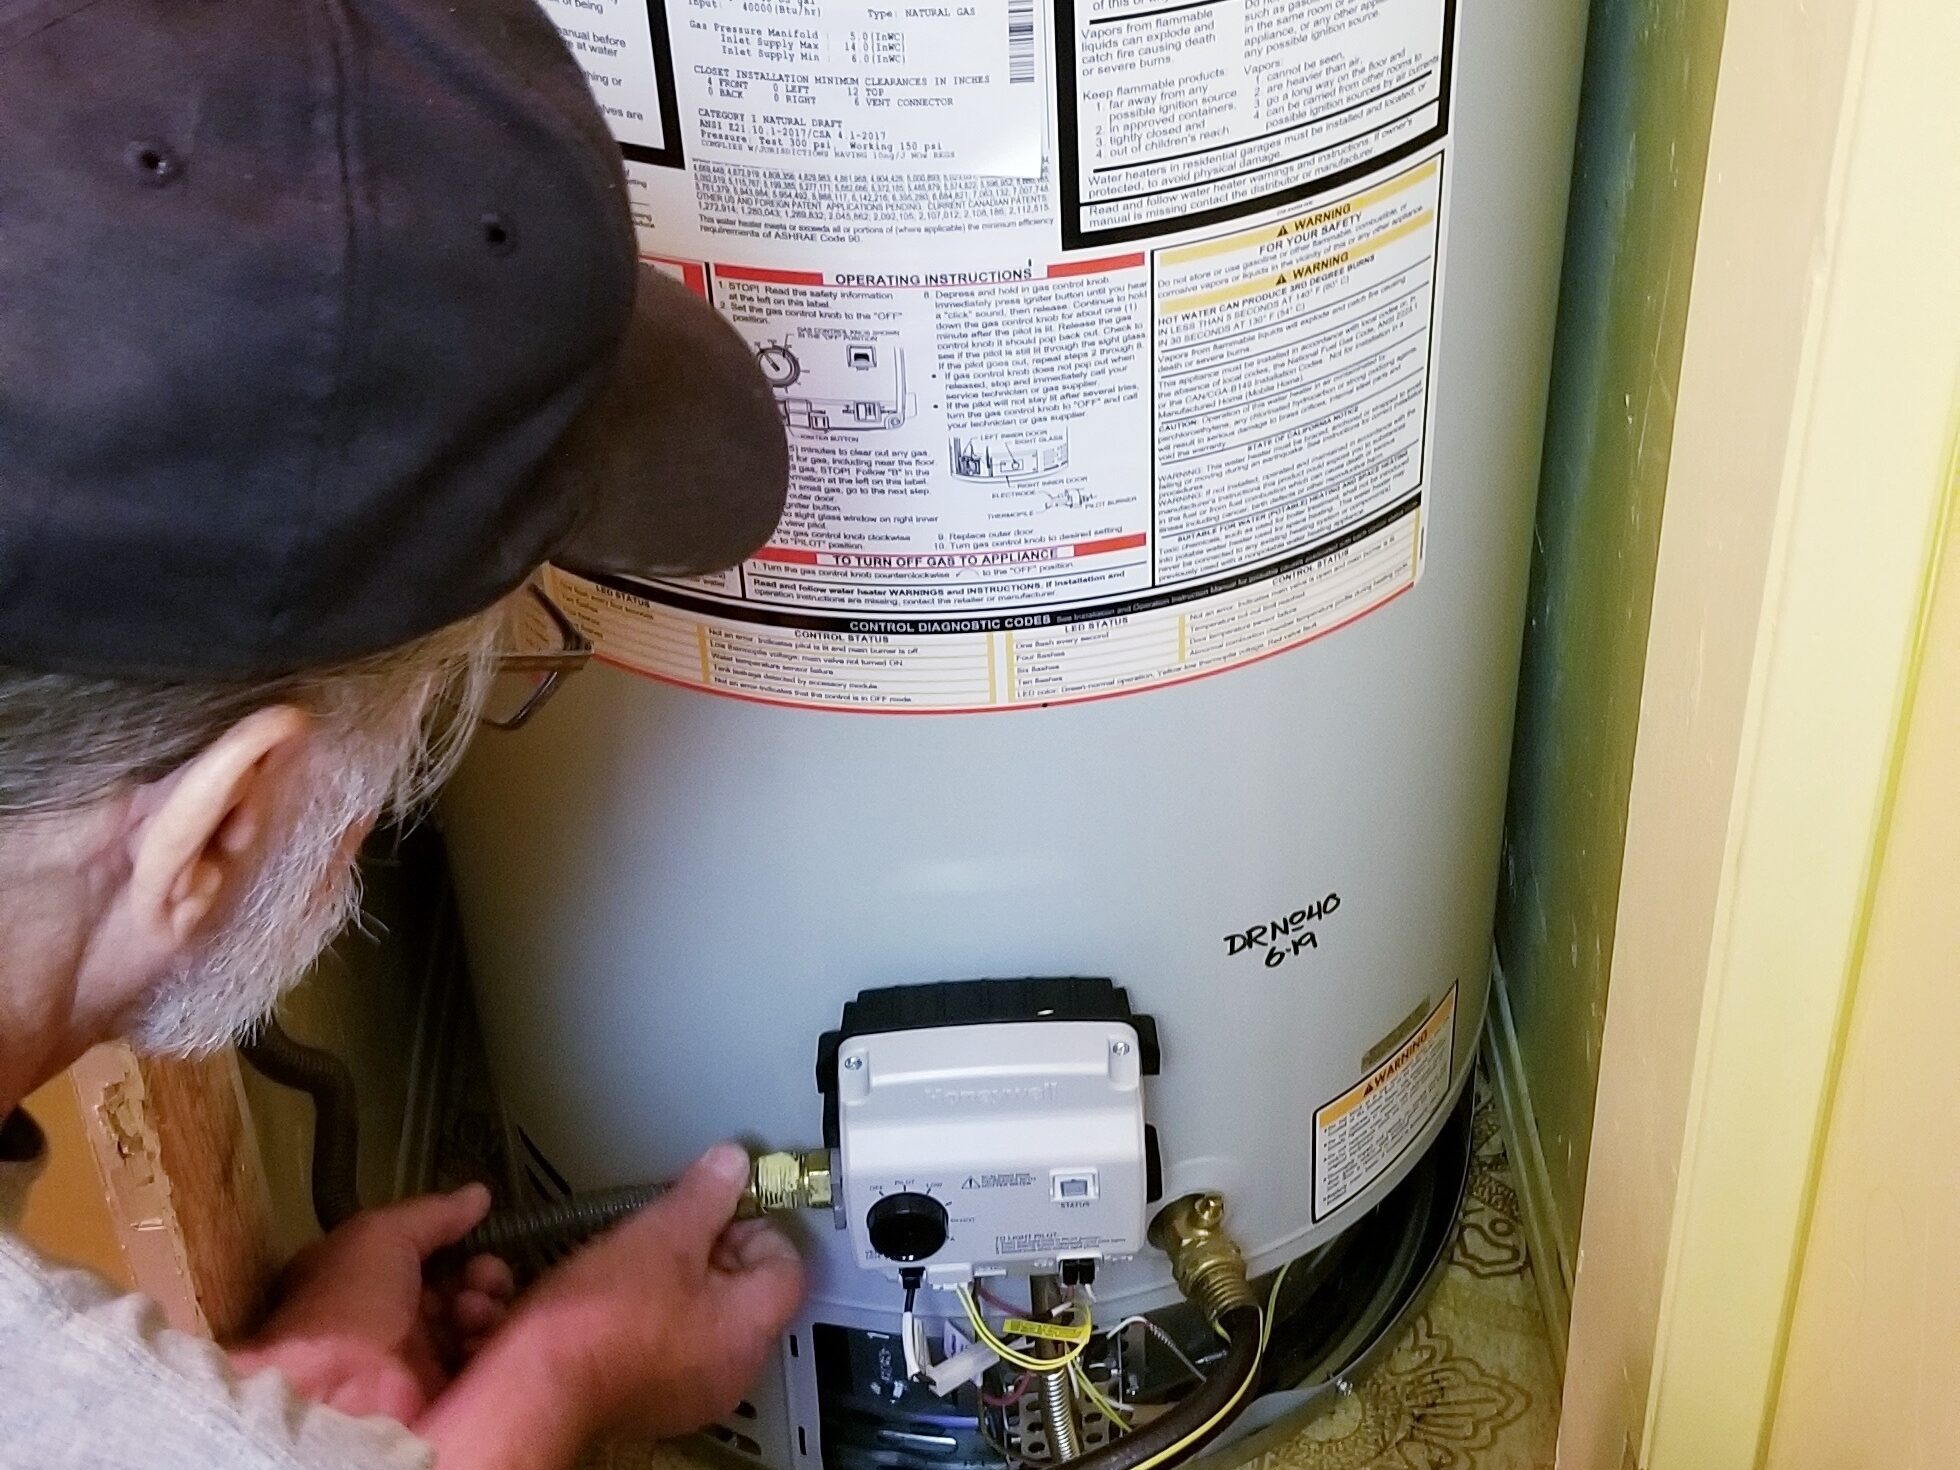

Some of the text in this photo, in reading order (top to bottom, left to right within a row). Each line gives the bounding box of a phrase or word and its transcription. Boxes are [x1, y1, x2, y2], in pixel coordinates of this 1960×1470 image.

[905, 8, 951, 17] NATURAL
[957, 8, 976, 17] GAS
[689, 20, 819, 40] Gas Pressure Manifold
[1081, 9, 1213, 39] Vapors from flammable
[592, 32, 626, 48] before
[721, 34, 819, 51] Inlet Supply Max
[1081, 21, 1215, 53] liquids can explode and
[589, 44, 618, 57] water
[722, 46, 820, 62] Inlet Supply Min
[1082, 33, 1216, 64] catch fire causing death
[694, 65, 990, 86] CLOSET INSTALLATION MINIMUM CLEARANCES IN INCHES
[1082, 67, 1093, 76] or
[1097, 62, 1136, 75] severe
[1266, 62, 1301, 81] cannot
[1304, 59, 1316, 70] be
[720, 79, 748, 90] FRONT
[785, 85, 809, 94] LEFT
[848, 88, 859, 97] 12
[866, 88, 884, 97] TOP
[720, 89, 743, 99] BACK
[786, 95, 816, 105] RIGHT
[866, 98, 891, 107] VENT
[897, 97, 954, 107] CONNECTOR
[1083, 89, 1113, 102] Keep
[1117, 79, 1175, 96] flammable
[1109, 84, 1208, 110] far away from any
[1110, 90, 1237, 122] possible ignition source
[698, 108, 745, 122] CATEGORY
[763, 115, 806, 126] NATURAL
[812, 119, 842, 128] DRAFT
[699, 119, 721, 130] ANSI
[1110, 120, 1206, 146] tightly closed and
[760, 136, 783, 146] Test
[790, 139, 807, 147] 300
[850, 142, 893, 152] Working
[901, 141, 918, 150] 150
[924, 142, 942, 152] psi
[1088, 174, 1122, 186] Water
[1125, 166, 1167, 180] heaters
[1170, 162, 1180, 172] in
[1182, 150, 1237, 169] residential
[1240, 140, 1281, 157] garages
[1285, 130, 1309, 144] must
[1311, 125, 1323, 136] be
[1325, 111, 1364, 131] installed
[1366, 101, 1382, 118] and
[1110, 146, 1127, 157] out
[1131, 142, 1141, 154] of
[1145, 135, 1197, 151] children's
[1294, 203, 1351, 231] WARNING
[1259, 212, 1362, 255] FOR YOUR SAFETY
[1292, 252, 1349, 280] WARNING
[835, 268, 1031, 285] OPERATING INSTRUCTIONS
[765, 286, 790, 296] Read
[792, 287, 807, 296] the
[810, 288, 837, 299] safety
[840, 289, 893, 300] information
[1158, 315, 1178, 327] HOT
[1181, 308, 1217, 322] WATER
[1219, 301, 1240, 313] CAN
[1242, 287, 1287, 307] PRODUCE
[1309, 268, 1344, 286] DEGREE
[1347, 253, 1375, 272] BURNS
[833, 555, 851, 566] TO
[857, 555, 892, 567] TURN
[896, 556, 922, 568] OFF
[927, 555, 955, 567] GAS
[961, 556, 978, 567] TO
[1272, 549, 1349, 586] CONTROL STATUS
[753, 578, 777, 588] Read
[779, 581, 797, 590] and
[798, 584, 827, 593] follow
[829, 587, 854, 595] water
[857, 587, 886, 596] heater
[888, 587, 944, 596] WARNINGS
[946, 588, 964, 596] and
[1054, 574, 1106, 588] installation
[1108, 570, 1125, 580] and
[850, 614, 1051, 632] CONTROL DIAGNOSTIC CODES
[1064, 617, 1129, 633] LED STATUS
[794, 629, 889, 643] CONTROL STATUS
[1374, 1029, 1428, 1087] WARNING
